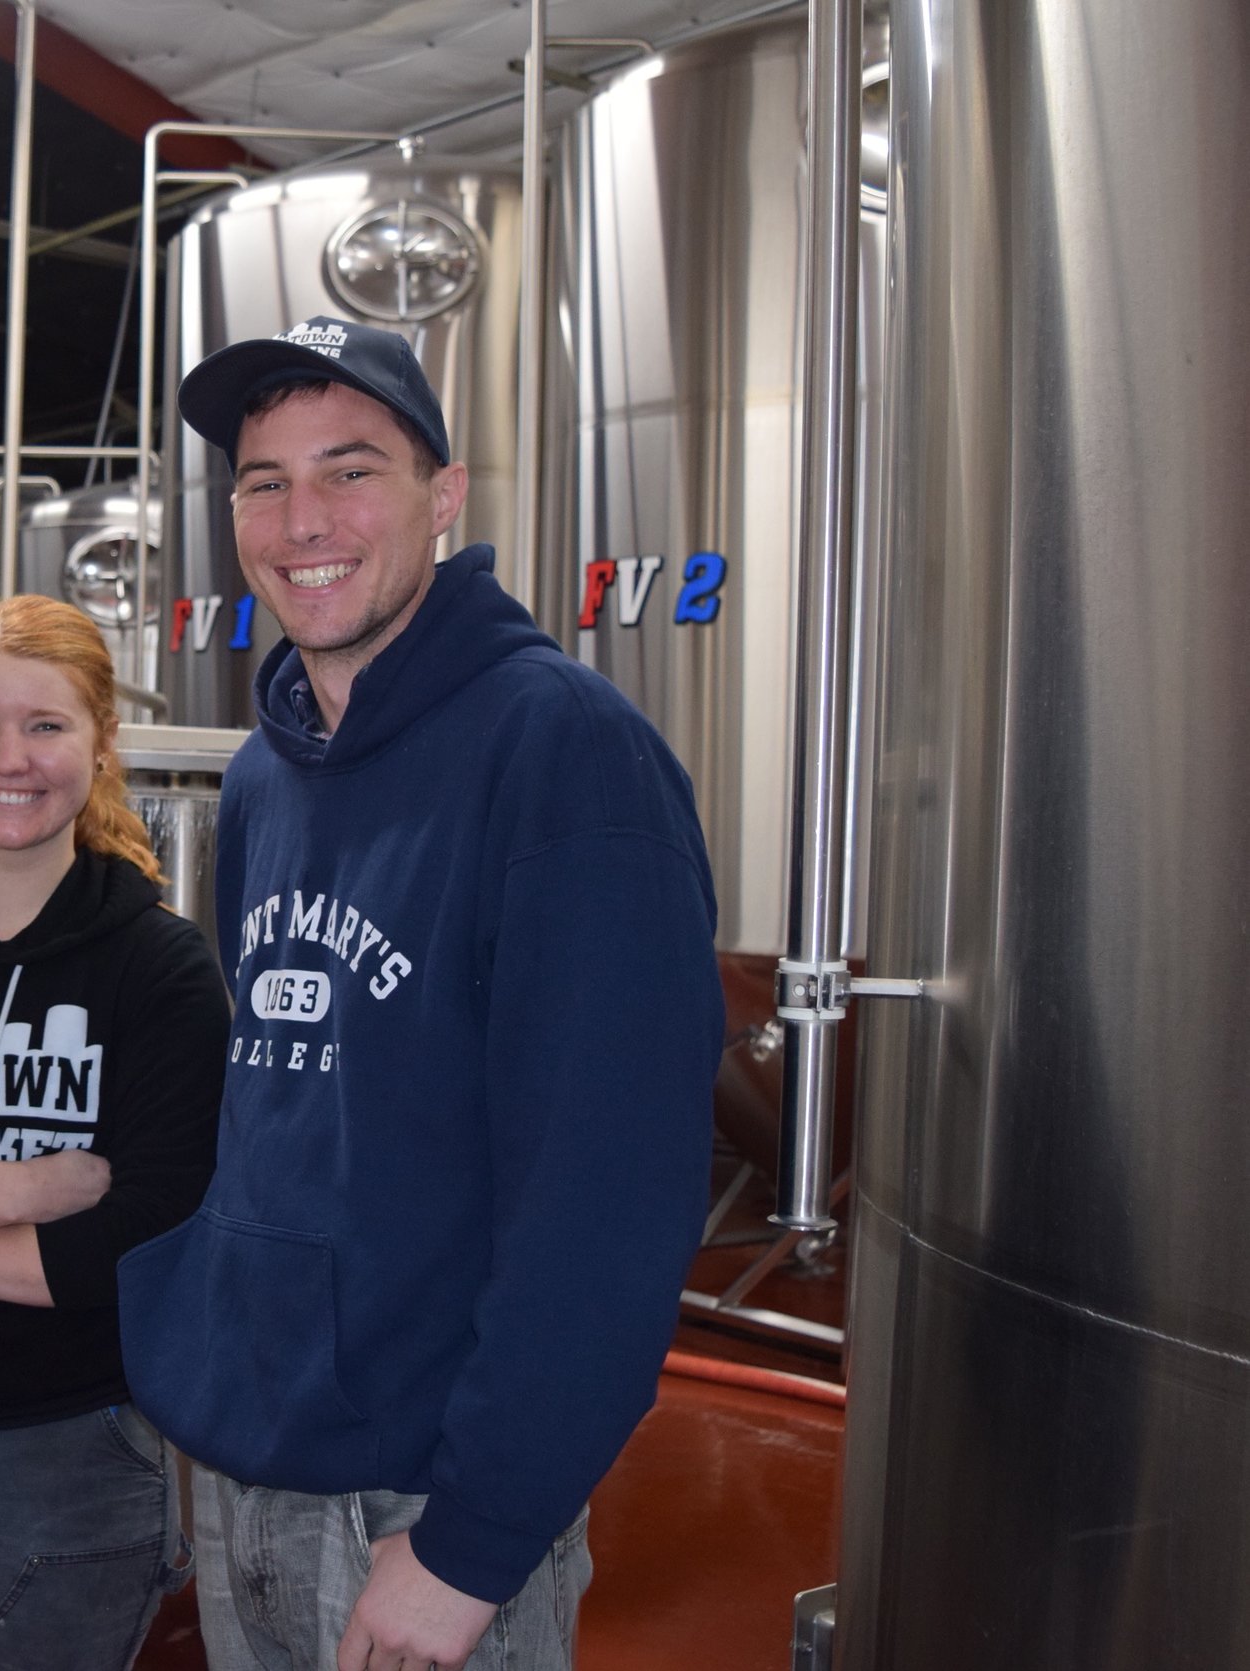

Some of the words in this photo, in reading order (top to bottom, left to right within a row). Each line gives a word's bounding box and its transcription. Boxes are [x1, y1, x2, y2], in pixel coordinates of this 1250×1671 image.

[579, 556, 663, 628] FV
[674, 552, 726, 625] 2
[170, 594, 222, 653] FV
[230, 592, 255, 650] 1
[287, 889, 412, 1000] MARY'S
[264, 977, 320, 1014] 1863
[231, 1037, 340, 1072] OLLEG
